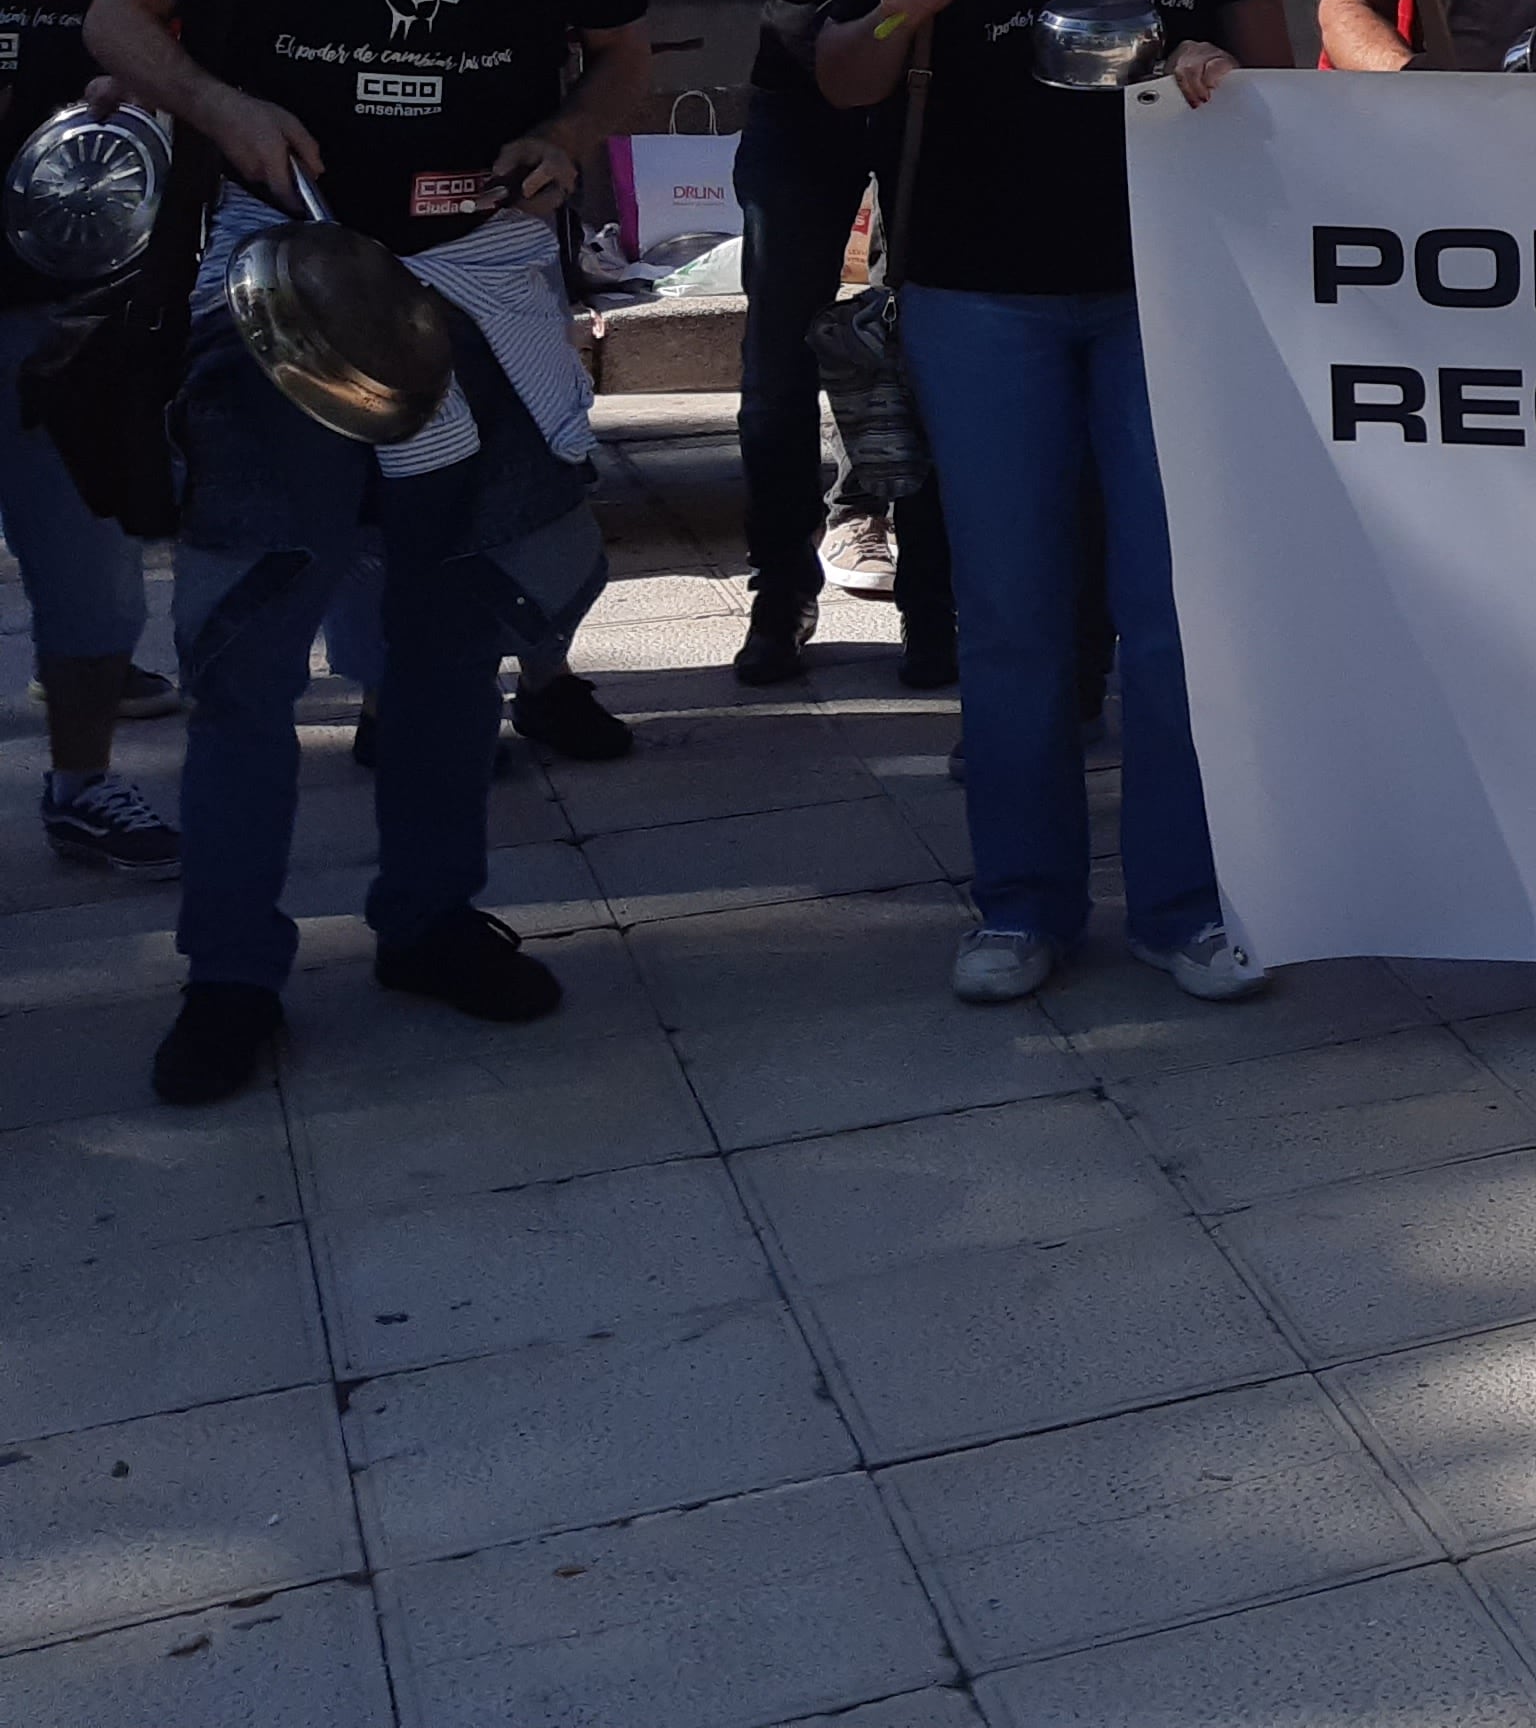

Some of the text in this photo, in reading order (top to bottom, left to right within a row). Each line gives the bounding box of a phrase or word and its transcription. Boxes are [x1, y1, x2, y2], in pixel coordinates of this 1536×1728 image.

[295, 43, 350, 64] poder
[353, 44, 378, 63] de
[364, 79, 437, 98] CCOO
[354, 103, 442, 116] enseñanza
[420, 179, 475, 195] CCOO
[415, 200, 462, 215] Ciuda
